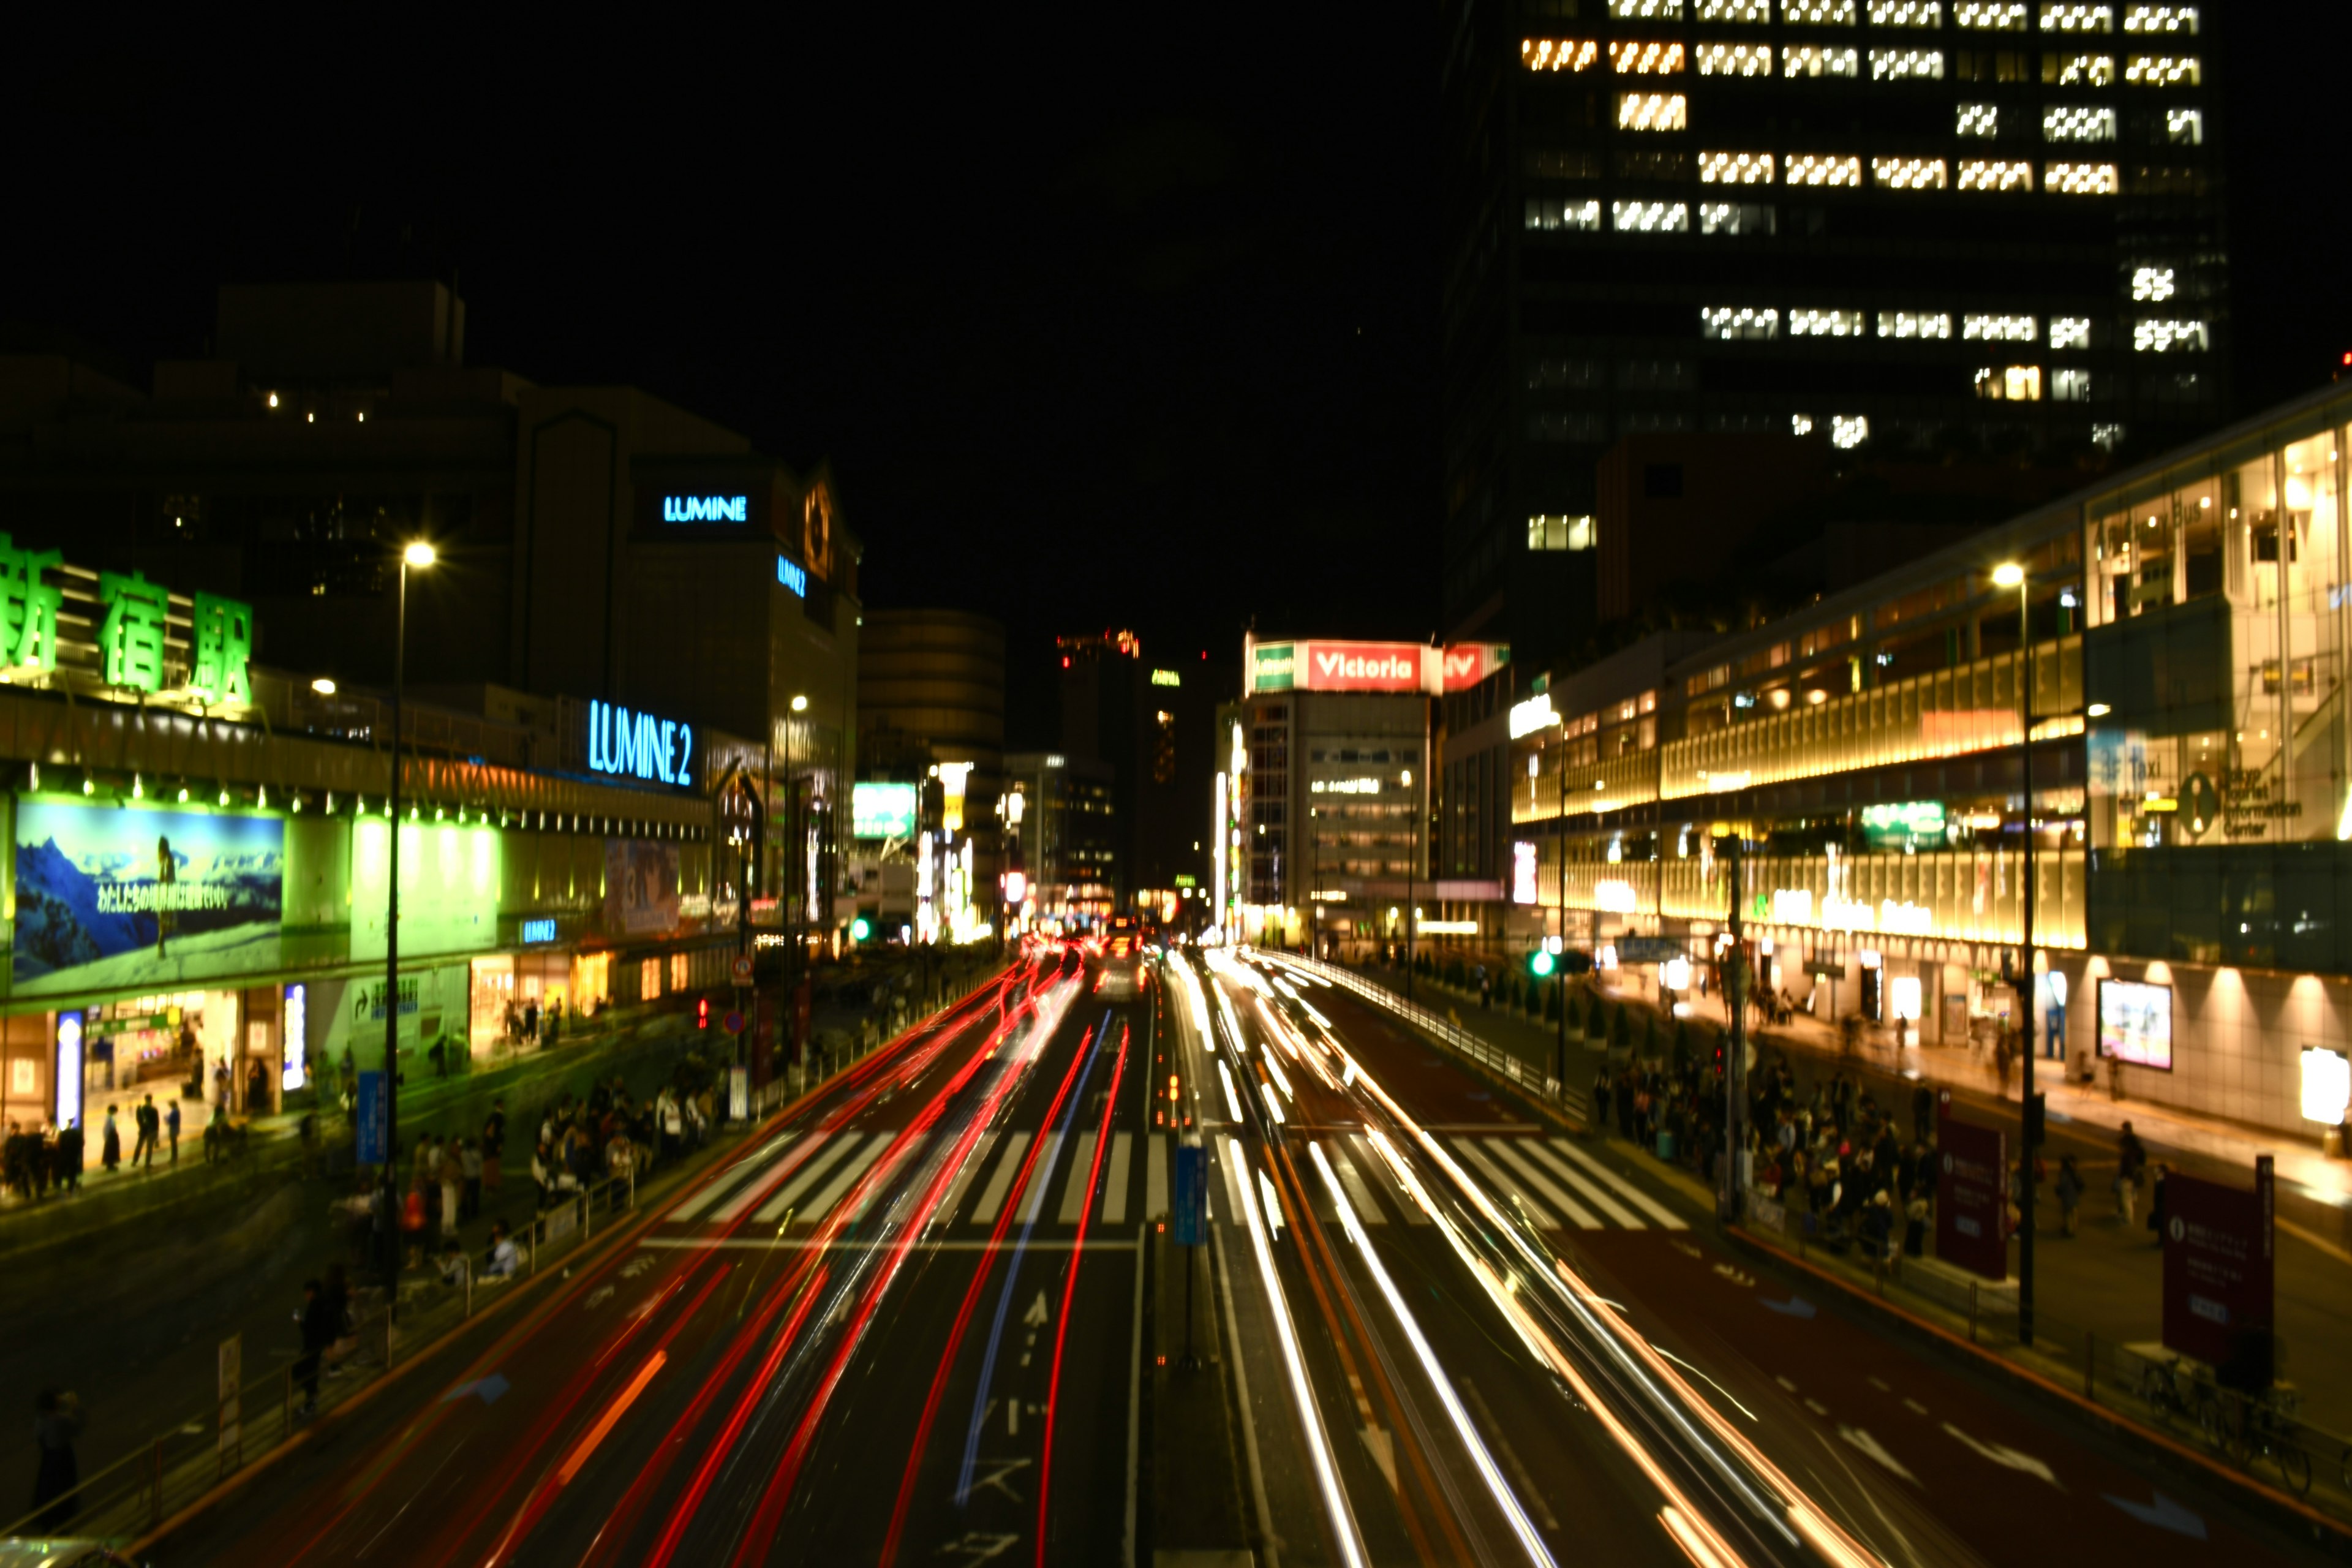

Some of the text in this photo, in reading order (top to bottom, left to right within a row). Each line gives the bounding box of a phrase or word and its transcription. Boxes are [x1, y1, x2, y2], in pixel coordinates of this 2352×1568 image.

[664, 496, 747, 522] LUMINE
[777, 554, 806, 598] LUMINE 2
[0, 532, 252, 706] 新宿駅
[1316, 652, 1412, 679] Victoria
[589, 700, 692, 786] LUMINE 2
[2224, 801, 2303, 818] Information
[2224, 821, 2267, 837] Center
[525, 919, 556, 943] LUMINE 2
